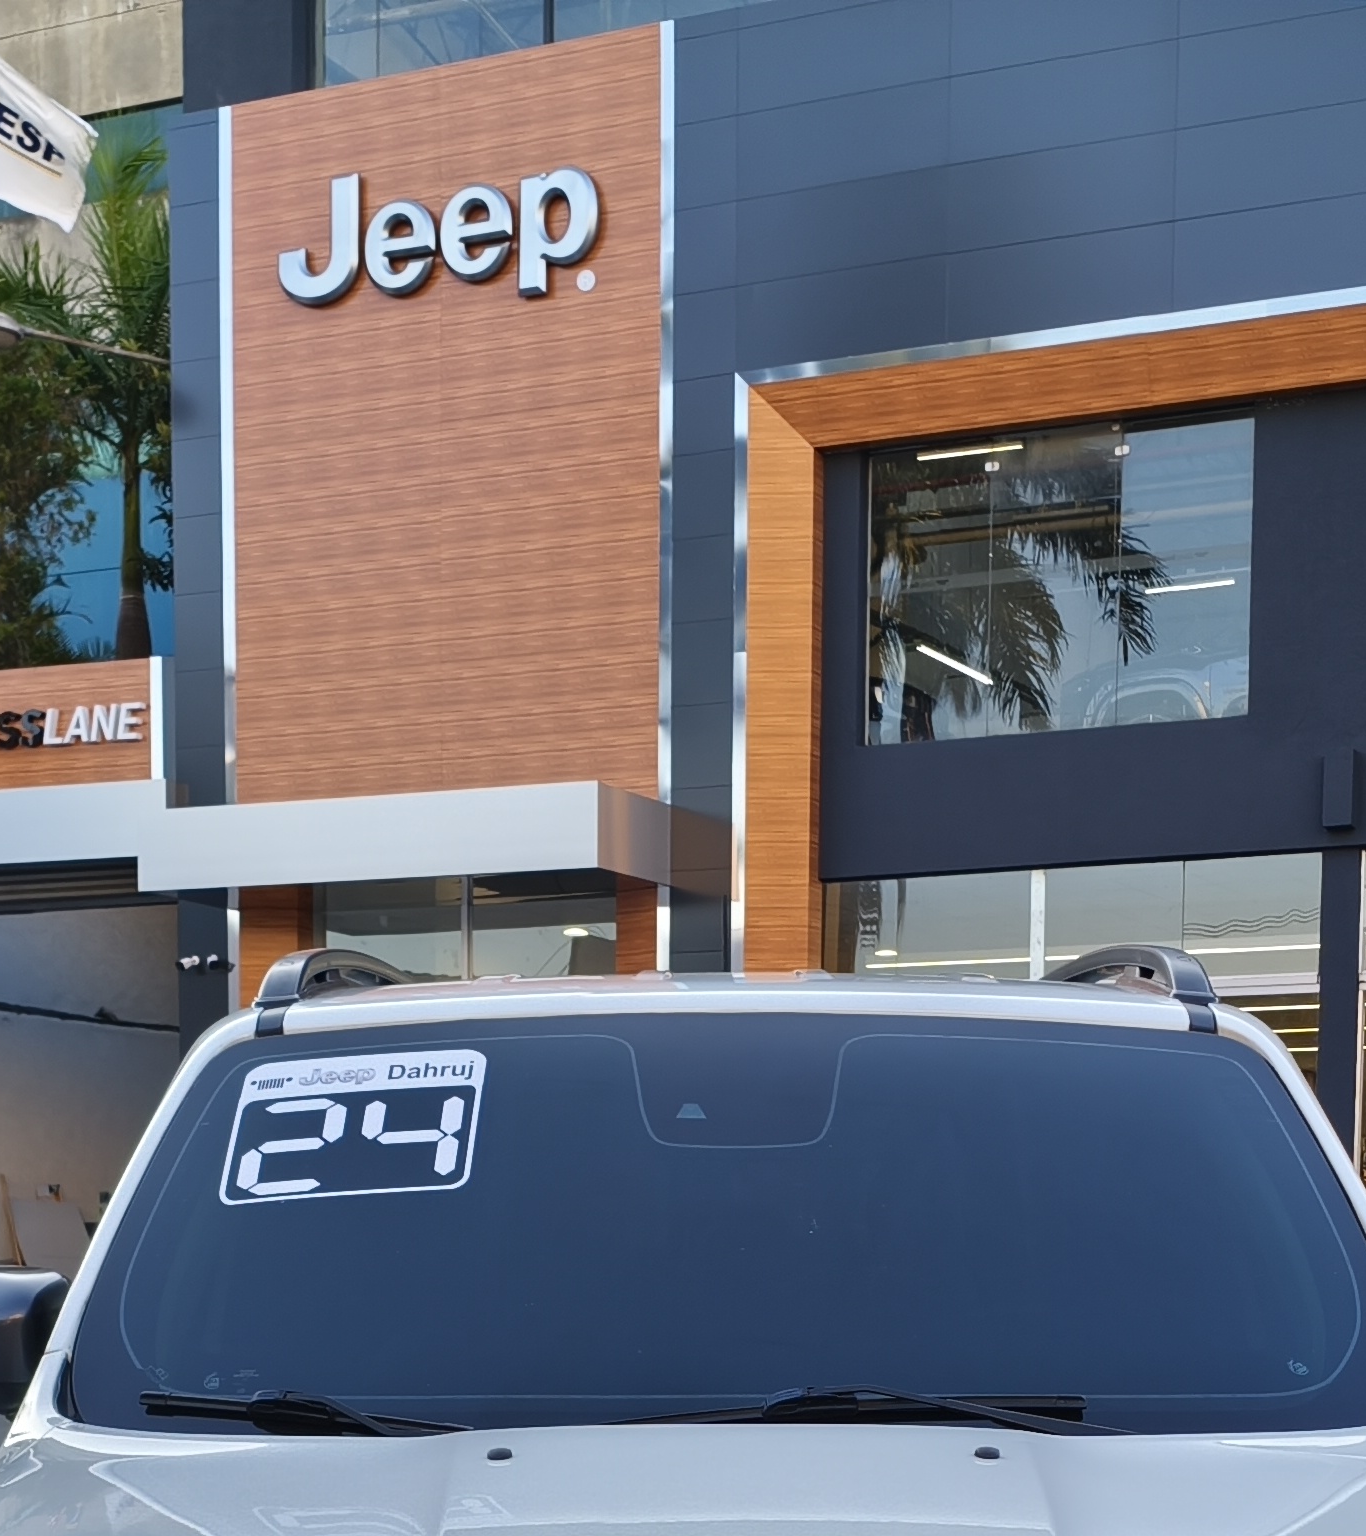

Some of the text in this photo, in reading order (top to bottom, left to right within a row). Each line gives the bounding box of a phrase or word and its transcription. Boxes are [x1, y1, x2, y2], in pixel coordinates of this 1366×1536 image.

[277, 165, 600, 306] Jeep
[298, 1060, 475, 1086] Jeep Dahruj
[236, 1096, 465, 1196] 24
